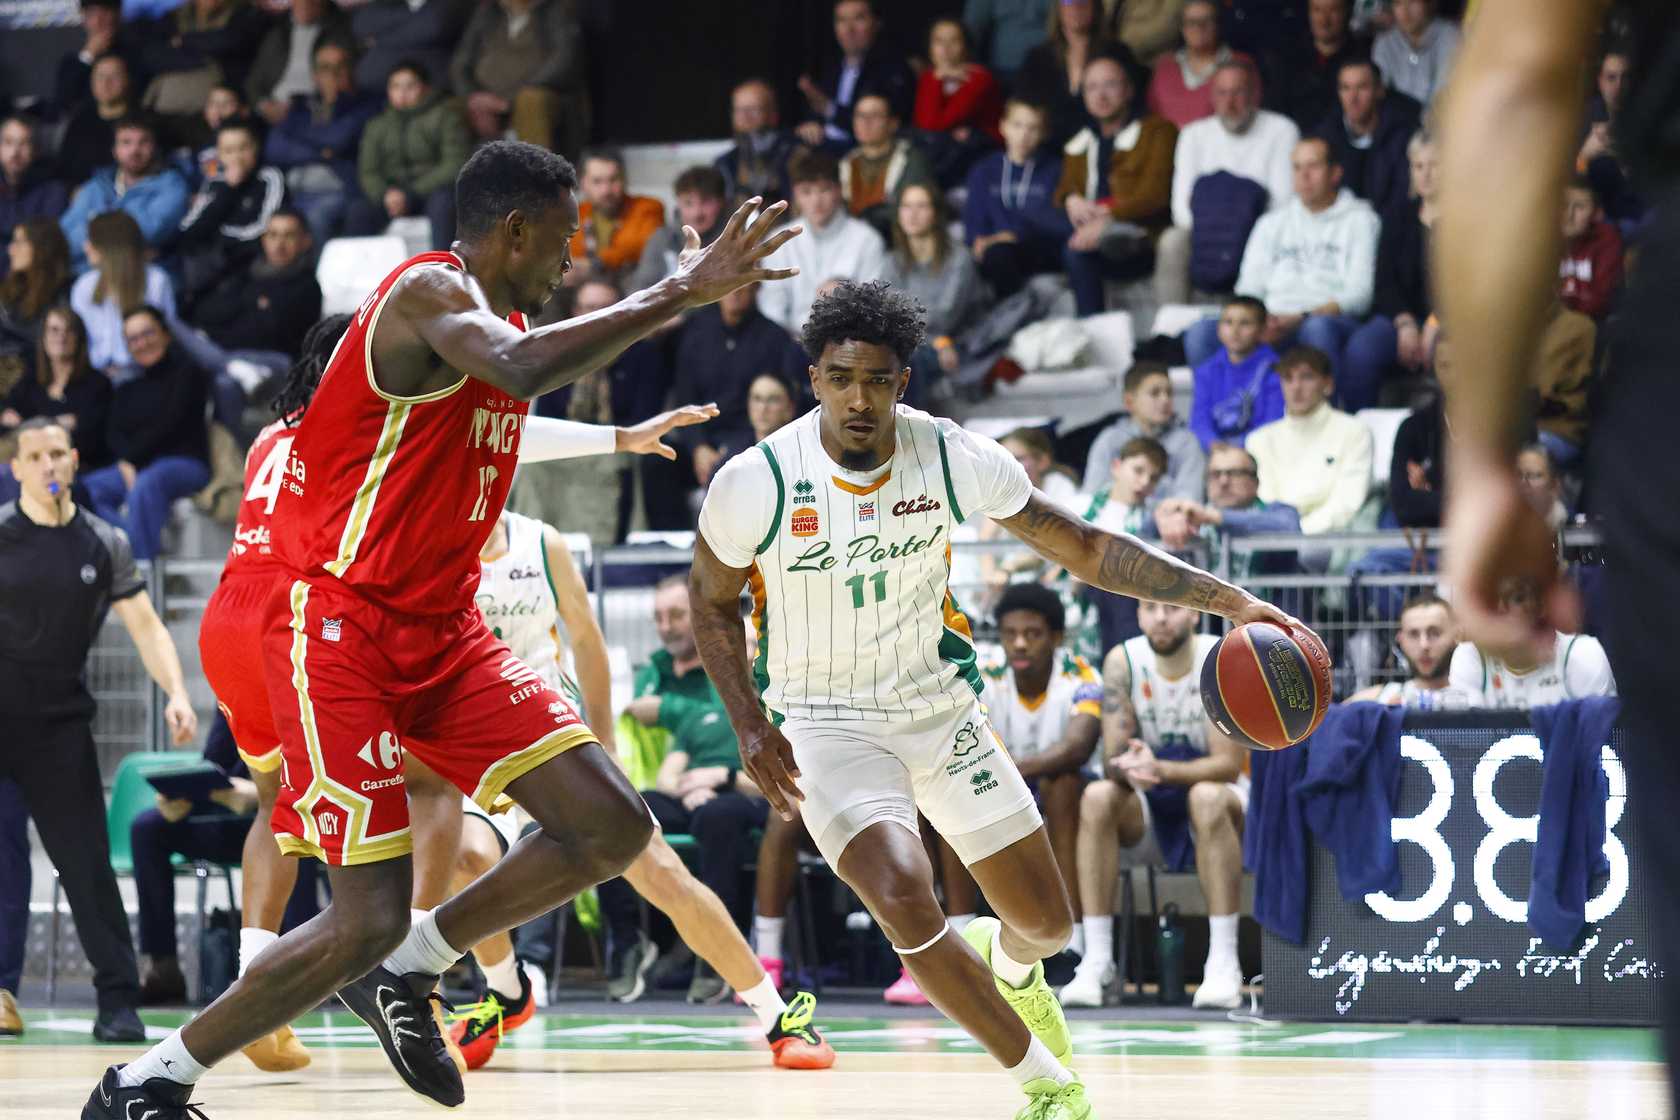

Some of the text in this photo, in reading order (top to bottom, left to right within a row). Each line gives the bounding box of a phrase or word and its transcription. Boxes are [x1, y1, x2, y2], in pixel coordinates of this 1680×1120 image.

[245, 435, 295, 515] 4
[791, 515, 819, 524] BURGER
[791, 523, 819, 532] KING
[787, 524, 943, 572] Le Portel
[845, 570, 889, 609] 11
